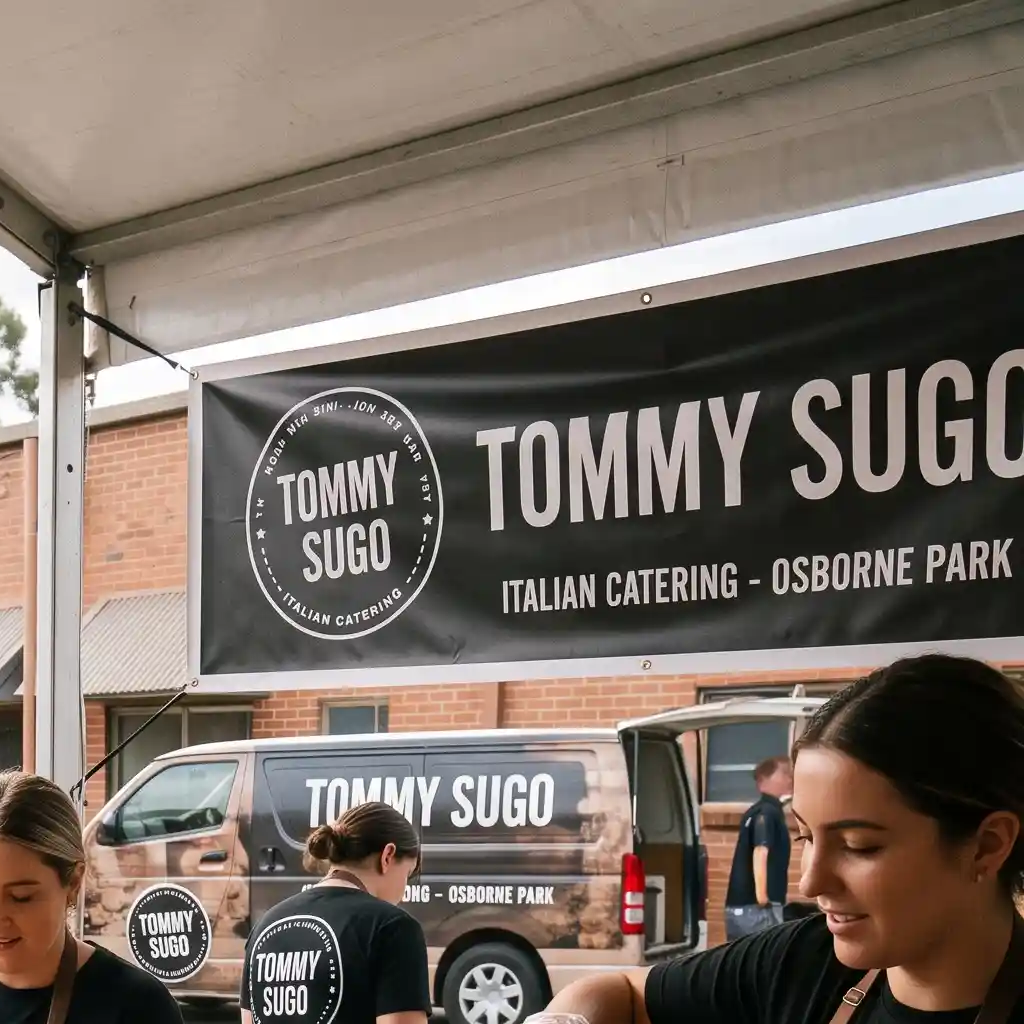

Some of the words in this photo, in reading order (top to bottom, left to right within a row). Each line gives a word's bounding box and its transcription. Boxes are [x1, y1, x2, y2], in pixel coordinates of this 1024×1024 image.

[476, 391, 761, 532] TOMMY
[790, 348, 1024, 501] SUGO
[276, 450, 398, 525] TOMMY
[302, 518, 392, 583] SUGO
[502, 573, 596, 614] ITALIAN
[606, 562, 738, 607] CATERING
[772, 546, 915, 595] OSBORNE
[926, 537, 1015, 584] PARK
[282, 592, 331, 626] ITALIAN
[335, 587, 403, 627] CATERING
[450, 772, 555, 828] SUGO
[448, 884, 514, 904] OSBORNE
[517, 886, 555, 905] PARK
[138, 910, 194, 937] TOMMY
[149, 934, 190, 959] SUGO
[255, 950, 323, 983] TOMMY
[262, 985, 308, 1017] SUGO
